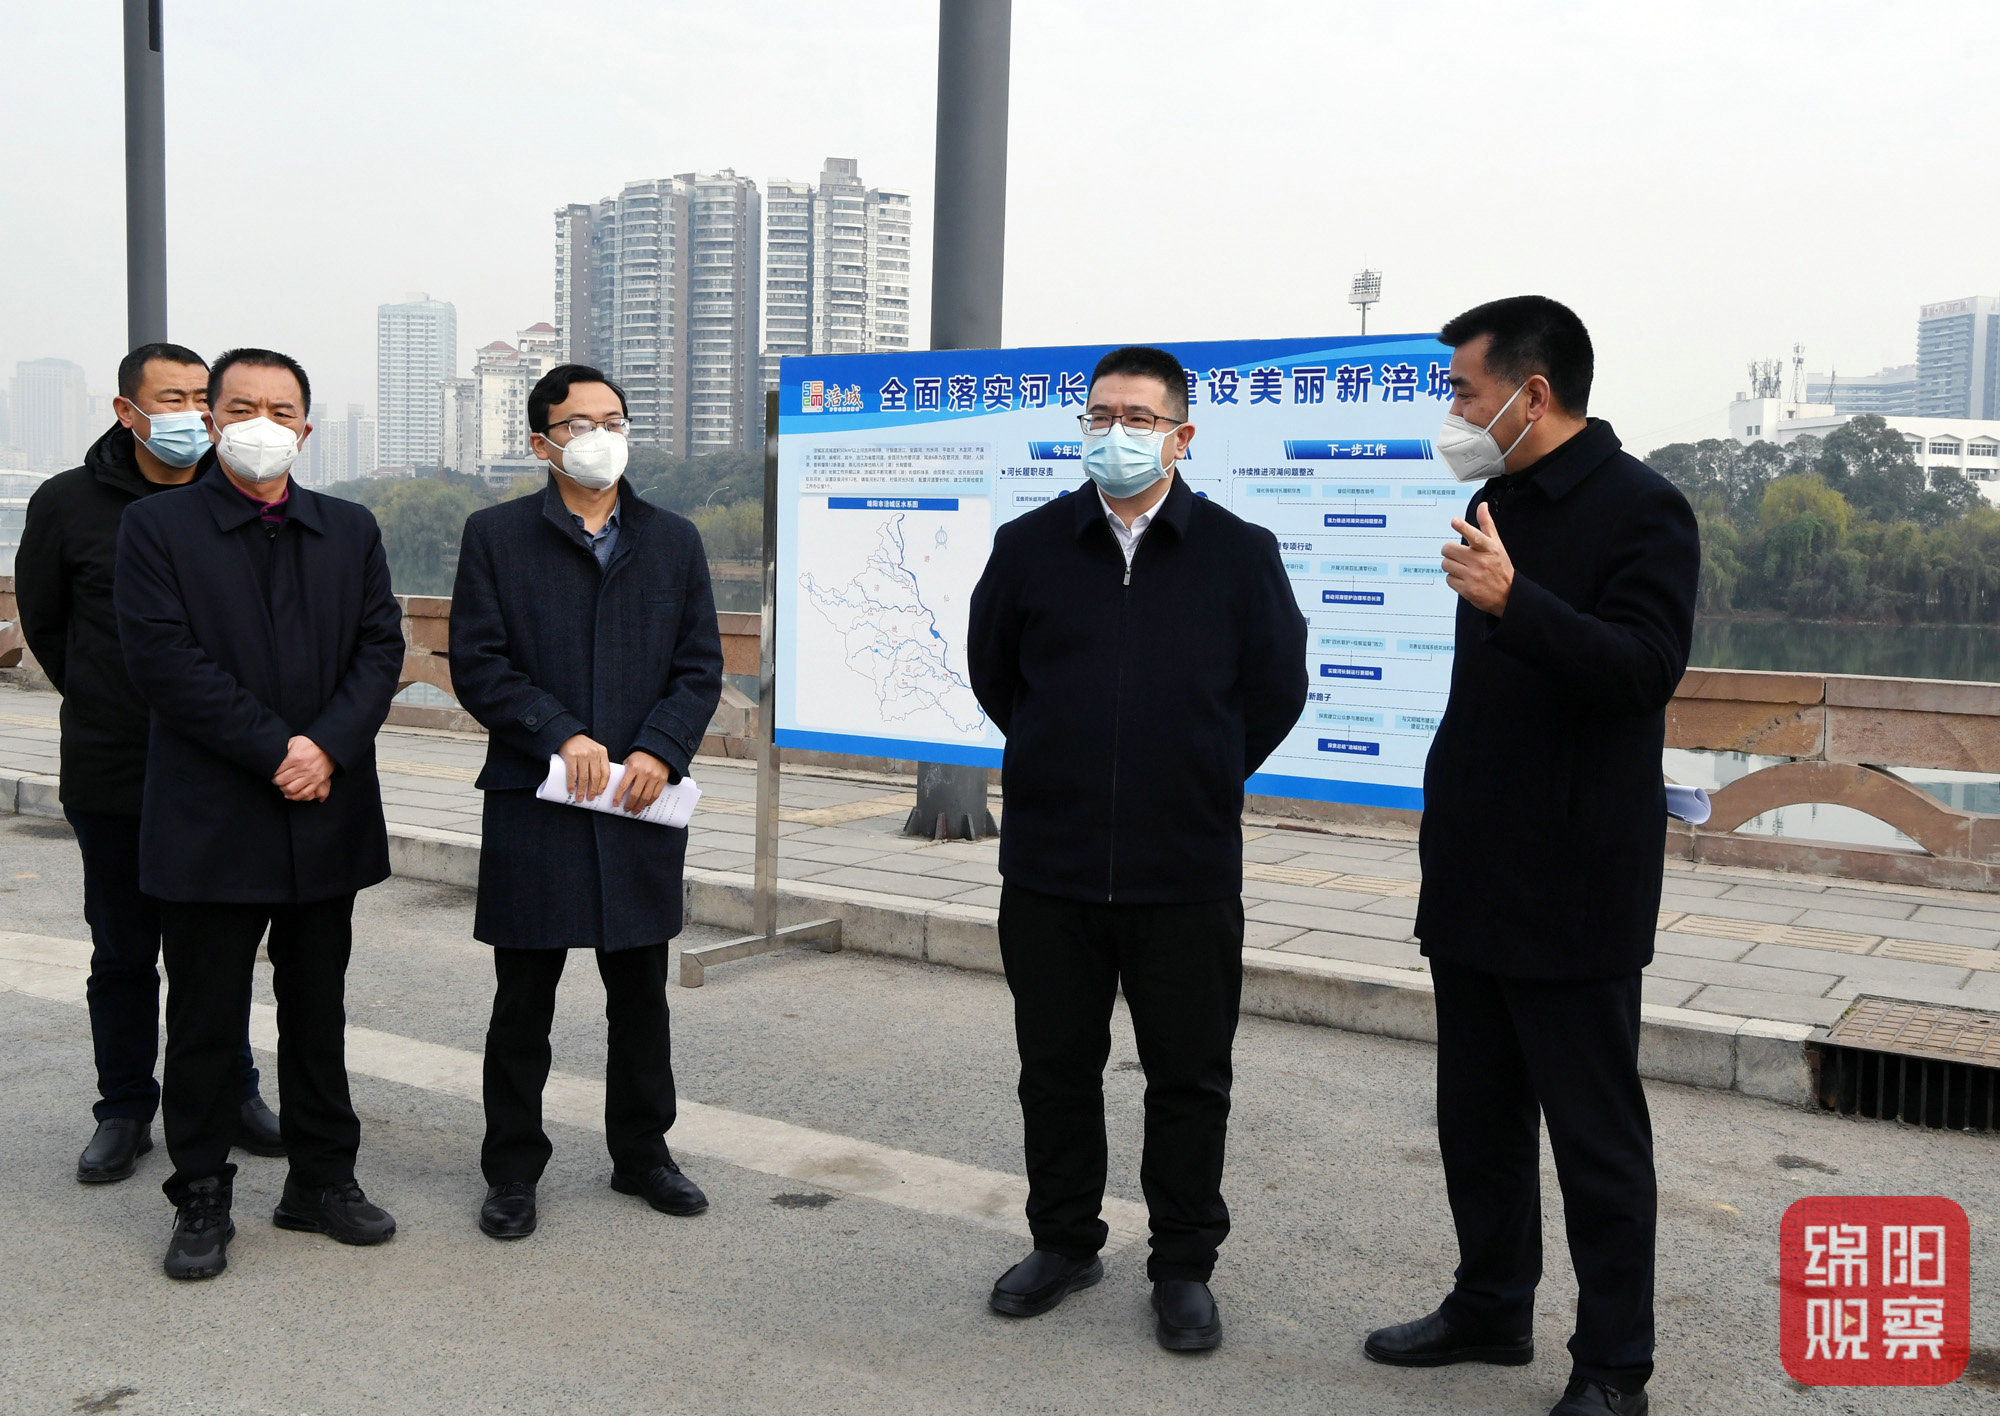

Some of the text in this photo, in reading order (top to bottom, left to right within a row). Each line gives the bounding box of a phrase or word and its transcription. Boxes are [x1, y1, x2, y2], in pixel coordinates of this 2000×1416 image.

[879, 372, 1088, 413] 全面落实河长
[1327, 443, 1388, 457] 下一步工作
[1006, 467, 1054, 477] 河长履职尽责
[1238, 467, 1315, 477] 持续推进河湖问题整改
